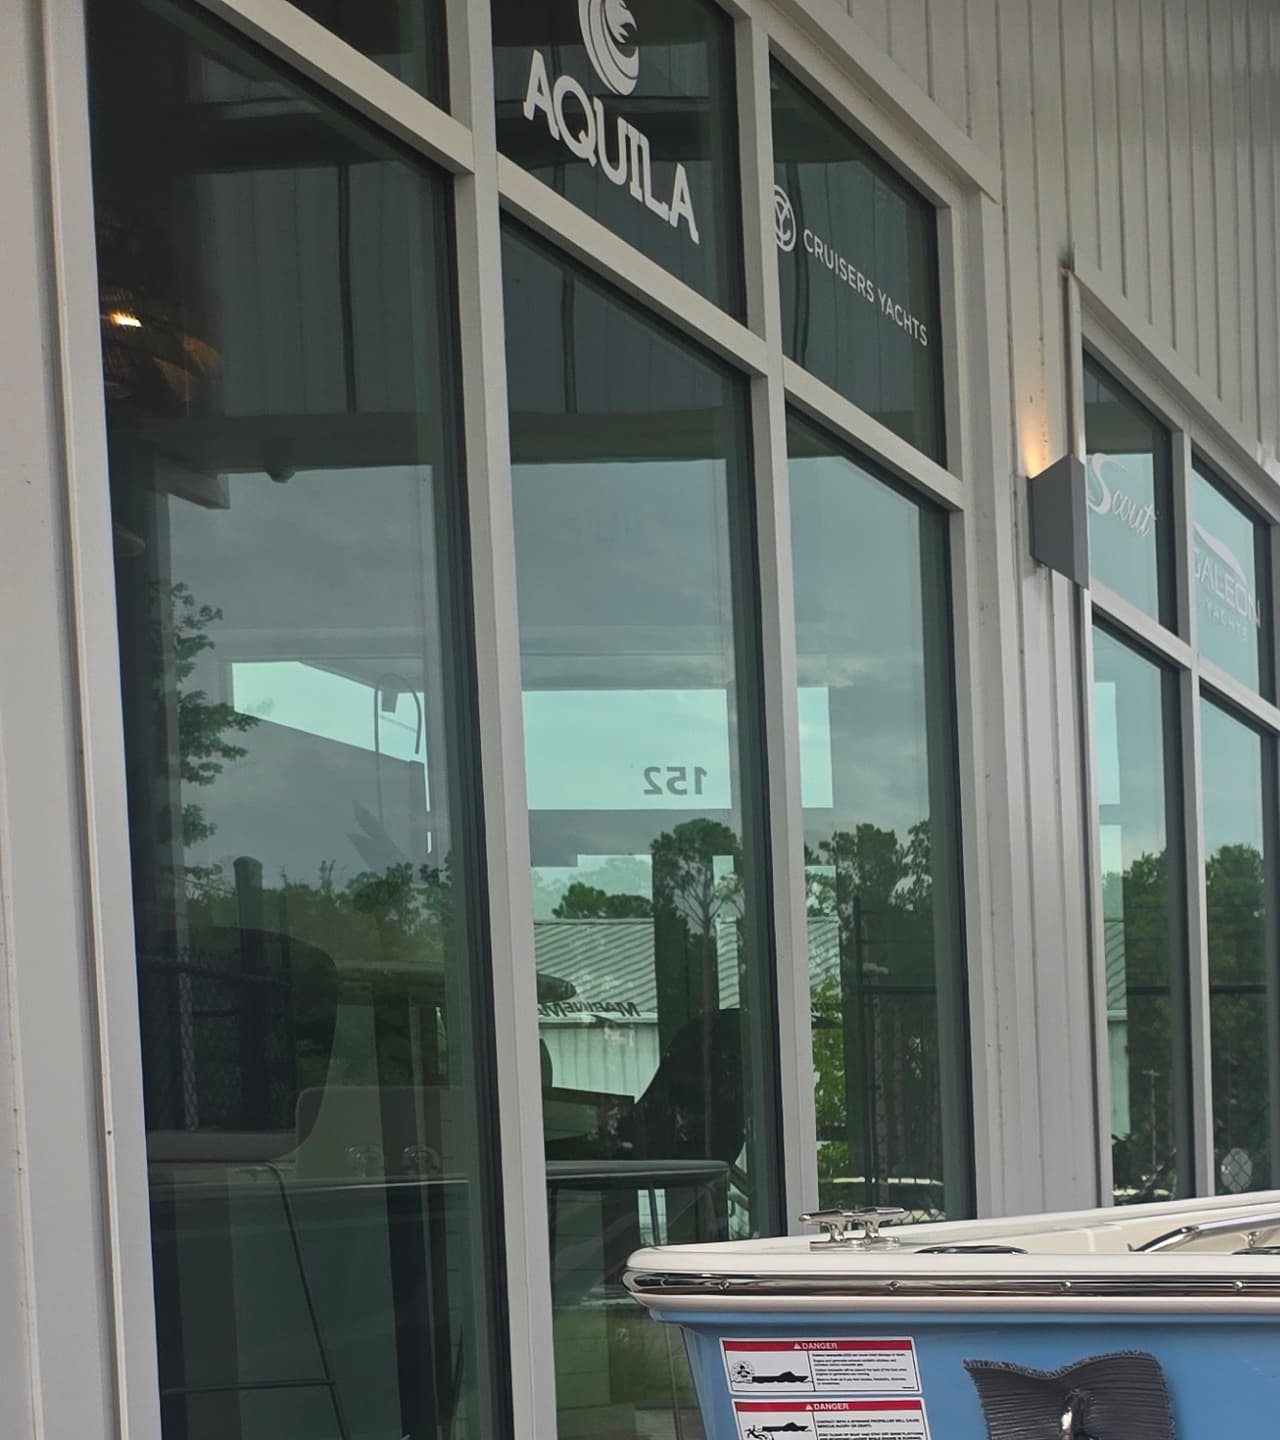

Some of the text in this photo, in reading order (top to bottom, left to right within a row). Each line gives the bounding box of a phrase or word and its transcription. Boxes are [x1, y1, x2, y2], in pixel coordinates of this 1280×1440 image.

[523, 49, 699, 245] AQUILA
[803, 229, 928, 346] CRUISERS YACHTS
[1087, 453, 1157, 536] Scout
[802, 1342, 838, 1350] DANGER
[814, 1403, 849, 1411] DANGER
